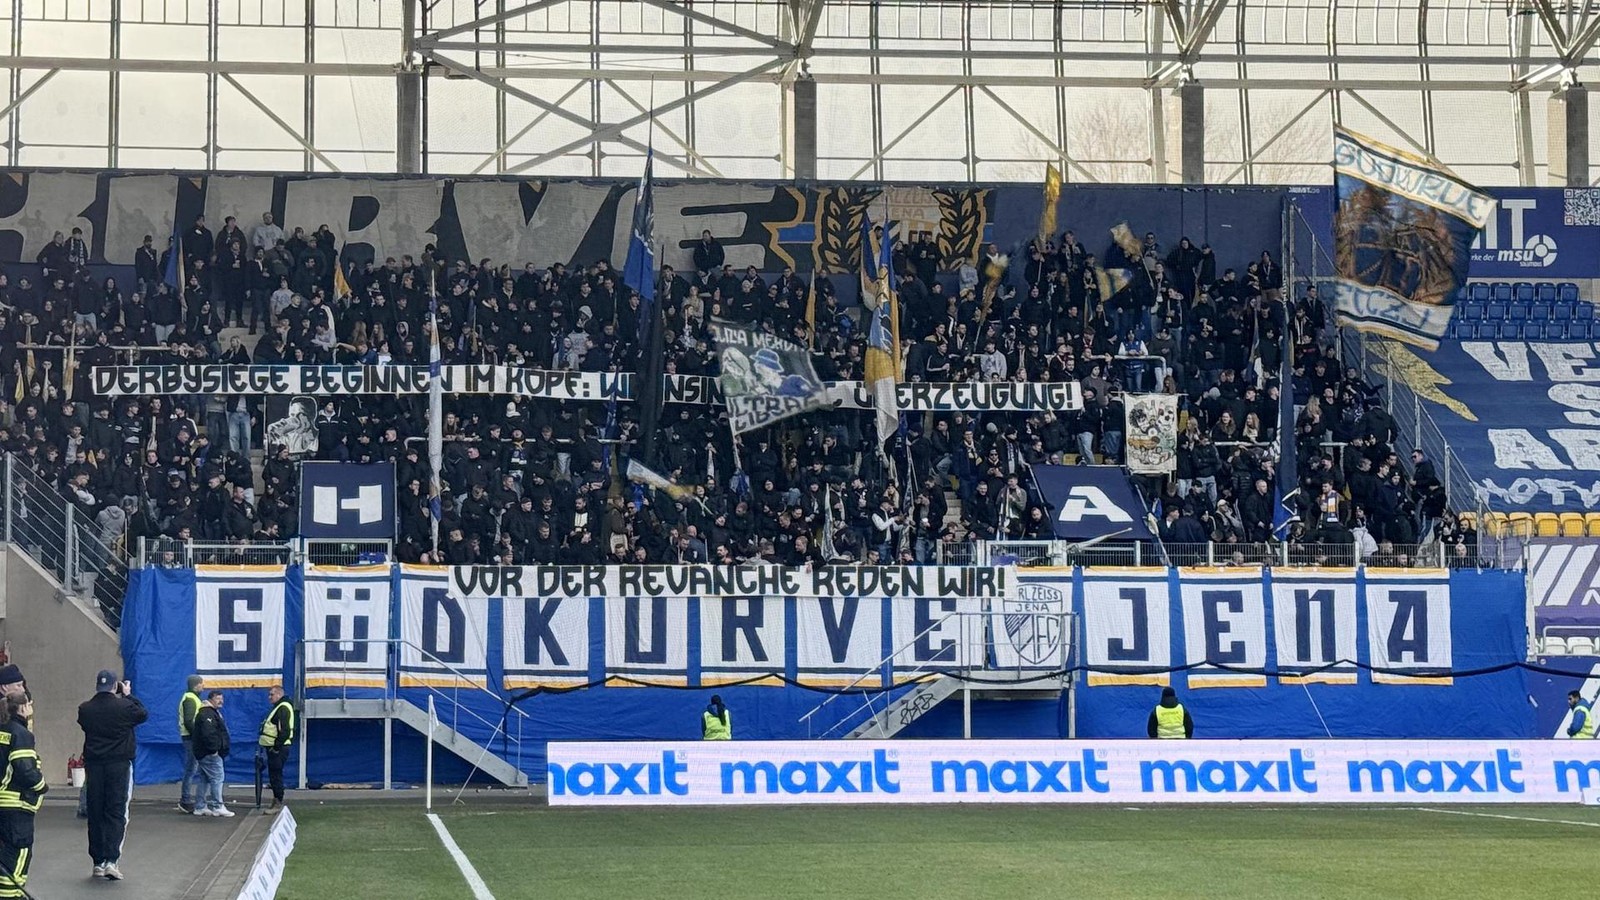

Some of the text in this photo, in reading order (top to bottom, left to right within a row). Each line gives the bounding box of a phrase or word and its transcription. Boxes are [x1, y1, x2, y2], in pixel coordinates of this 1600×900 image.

[1497, 250, 1534, 261] msu
[1461, 341, 1600, 382] VE
[95, 365, 290, 393] DERBYSIEGE
[300, 365, 453, 393] BEGINNEN
[465, 366, 495, 392] IM
[854, 382, 1073, 411] ÜERZEUGUNG!
[313, 485, 382, 525] H
[1058, 486, 1134, 522] A
[454, 565, 1005, 597] VOR DER REVANCHE REDEN WIR!
[1031, 587, 1059, 600] ZEISS
[1015, 603, 1050, 612] JENA
[720, 749, 900, 794] maxit
[930, 748, 1110, 793] maxit
[1140, 748, 1318, 794] maxit
[1347, 749, 1525, 794] maxit
